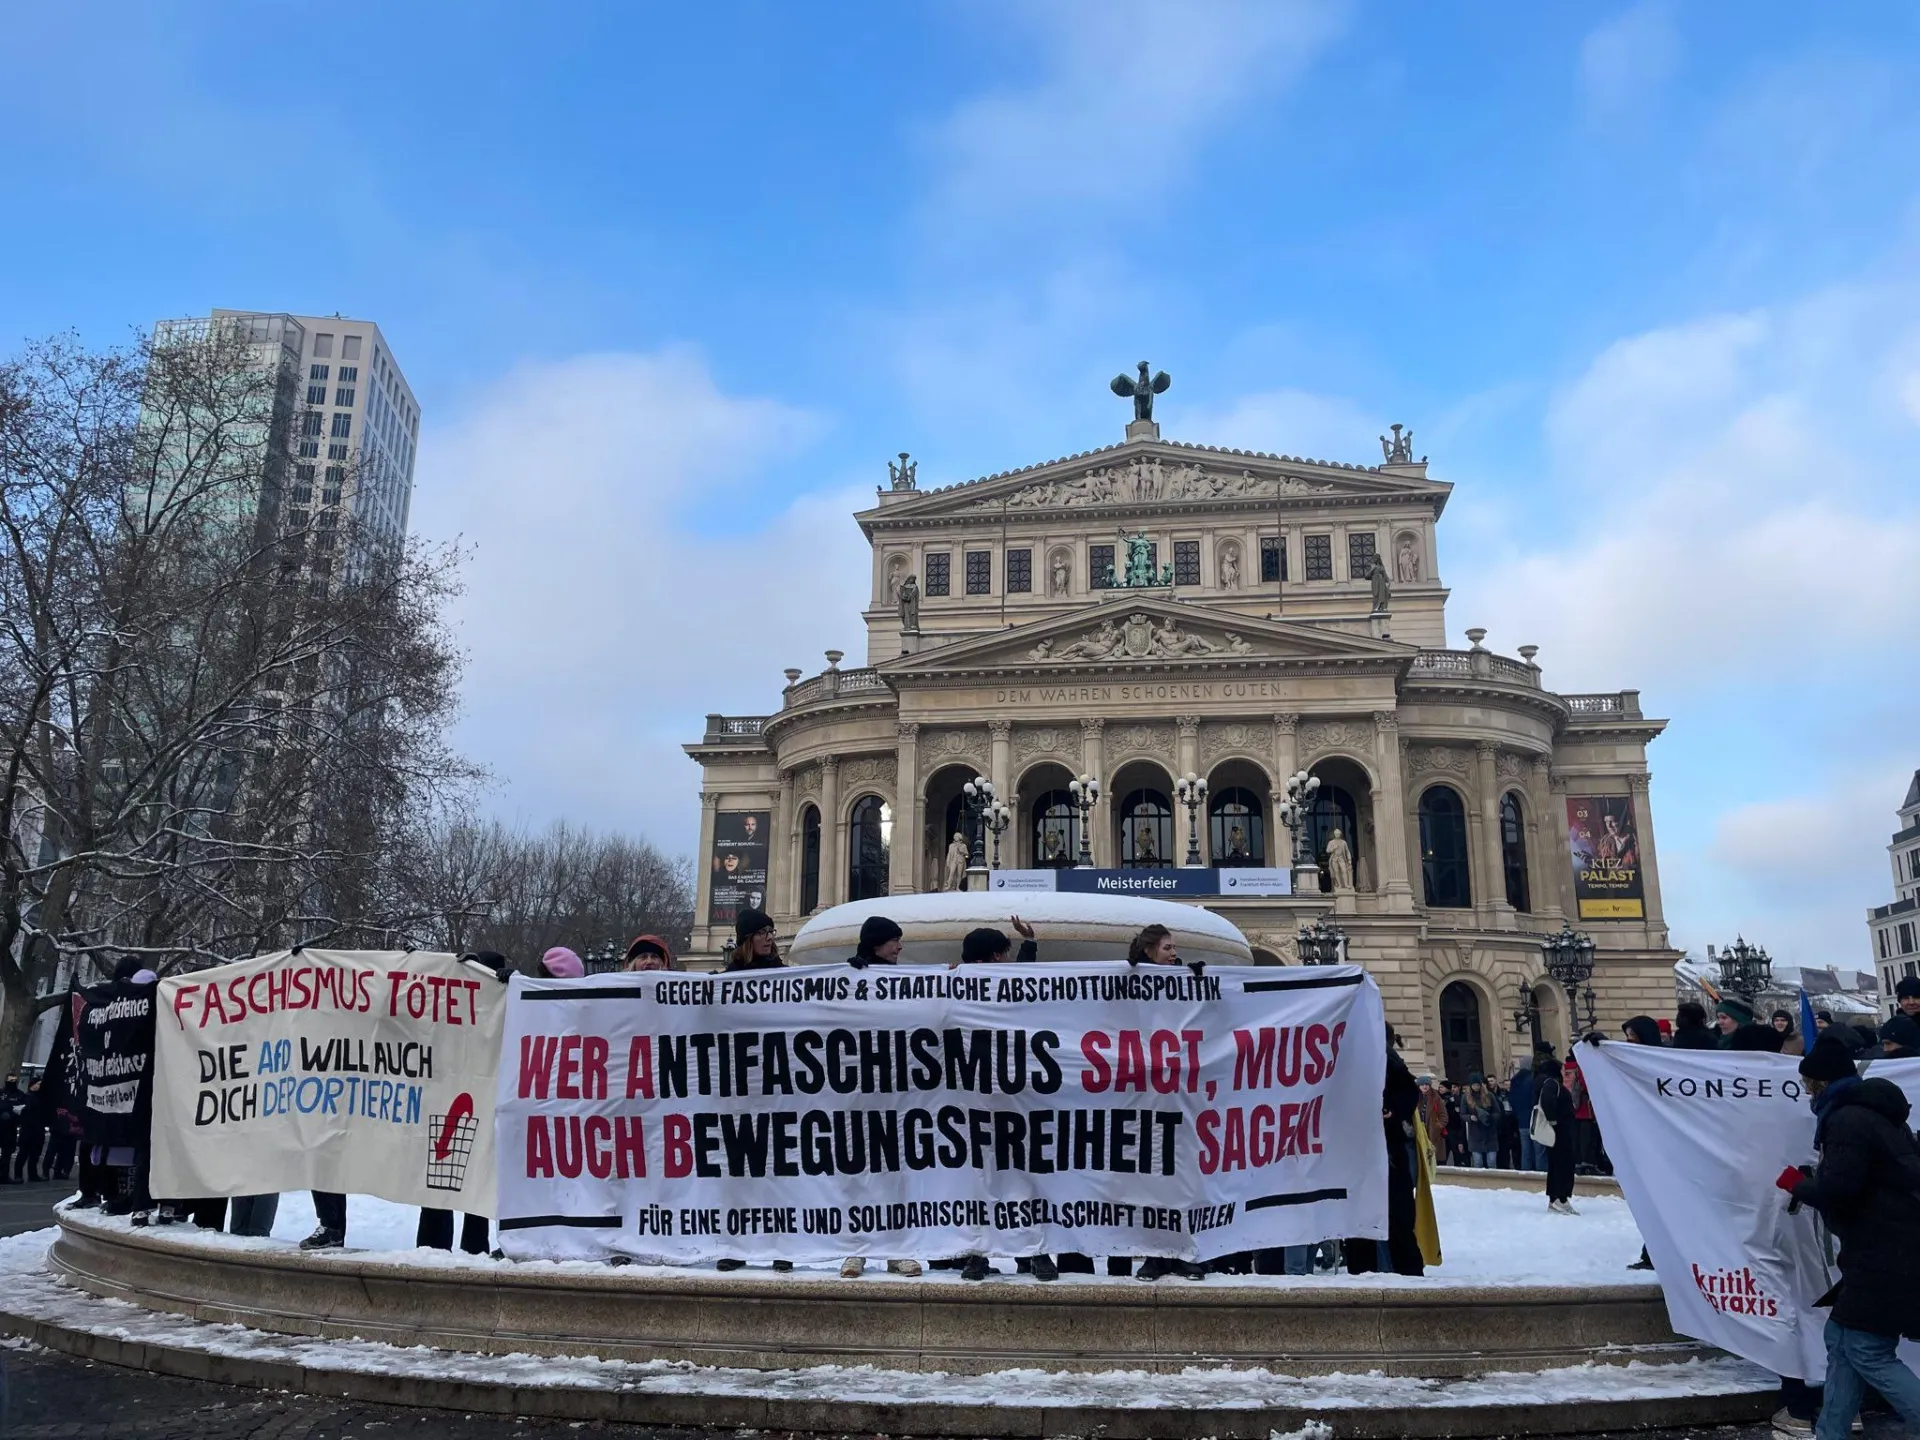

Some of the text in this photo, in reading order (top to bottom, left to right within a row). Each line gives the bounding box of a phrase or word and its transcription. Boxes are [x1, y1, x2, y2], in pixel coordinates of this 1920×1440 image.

[997, 690, 1031, 702] DEM
[1039, 688, 1111, 701] WAHREN
[1122, 684, 1214, 699] SCHOENEN
[1577, 810, 1588, 818] 03
[1580, 870, 1635, 881] PALAST
[1591, 858, 1623, 869] KIEZ
[1097, 876, 1178, 889] Meisterfeier
[174, 967, 481, 1030] FASCHISMUS TÖTET
[655, 974, 1222, 1005] GEGEN FASCHISMUS & STAATLICHE ABSCHOTTUNGSPOLITIK
[198, 1037, 432, 1083] DIE AfD WILL AUCH
[518, 1021, 1347, 1101] WER ANTIFASCHISMUS SAGT, MUSS
[195, 1076, 422, 1126] DICH DEPORTIEREN
[526, 1095, 1324, 1179] AUCH BEWEGUNGSFREIHEIT SAGEN!
[639, 1198, 1236, 1236] FÜR EINE OFFENE UND SOLIDARISCHE GESELLSCHAFT DER VIELEN
[1692, 1263, 1756, 1295] kritik
